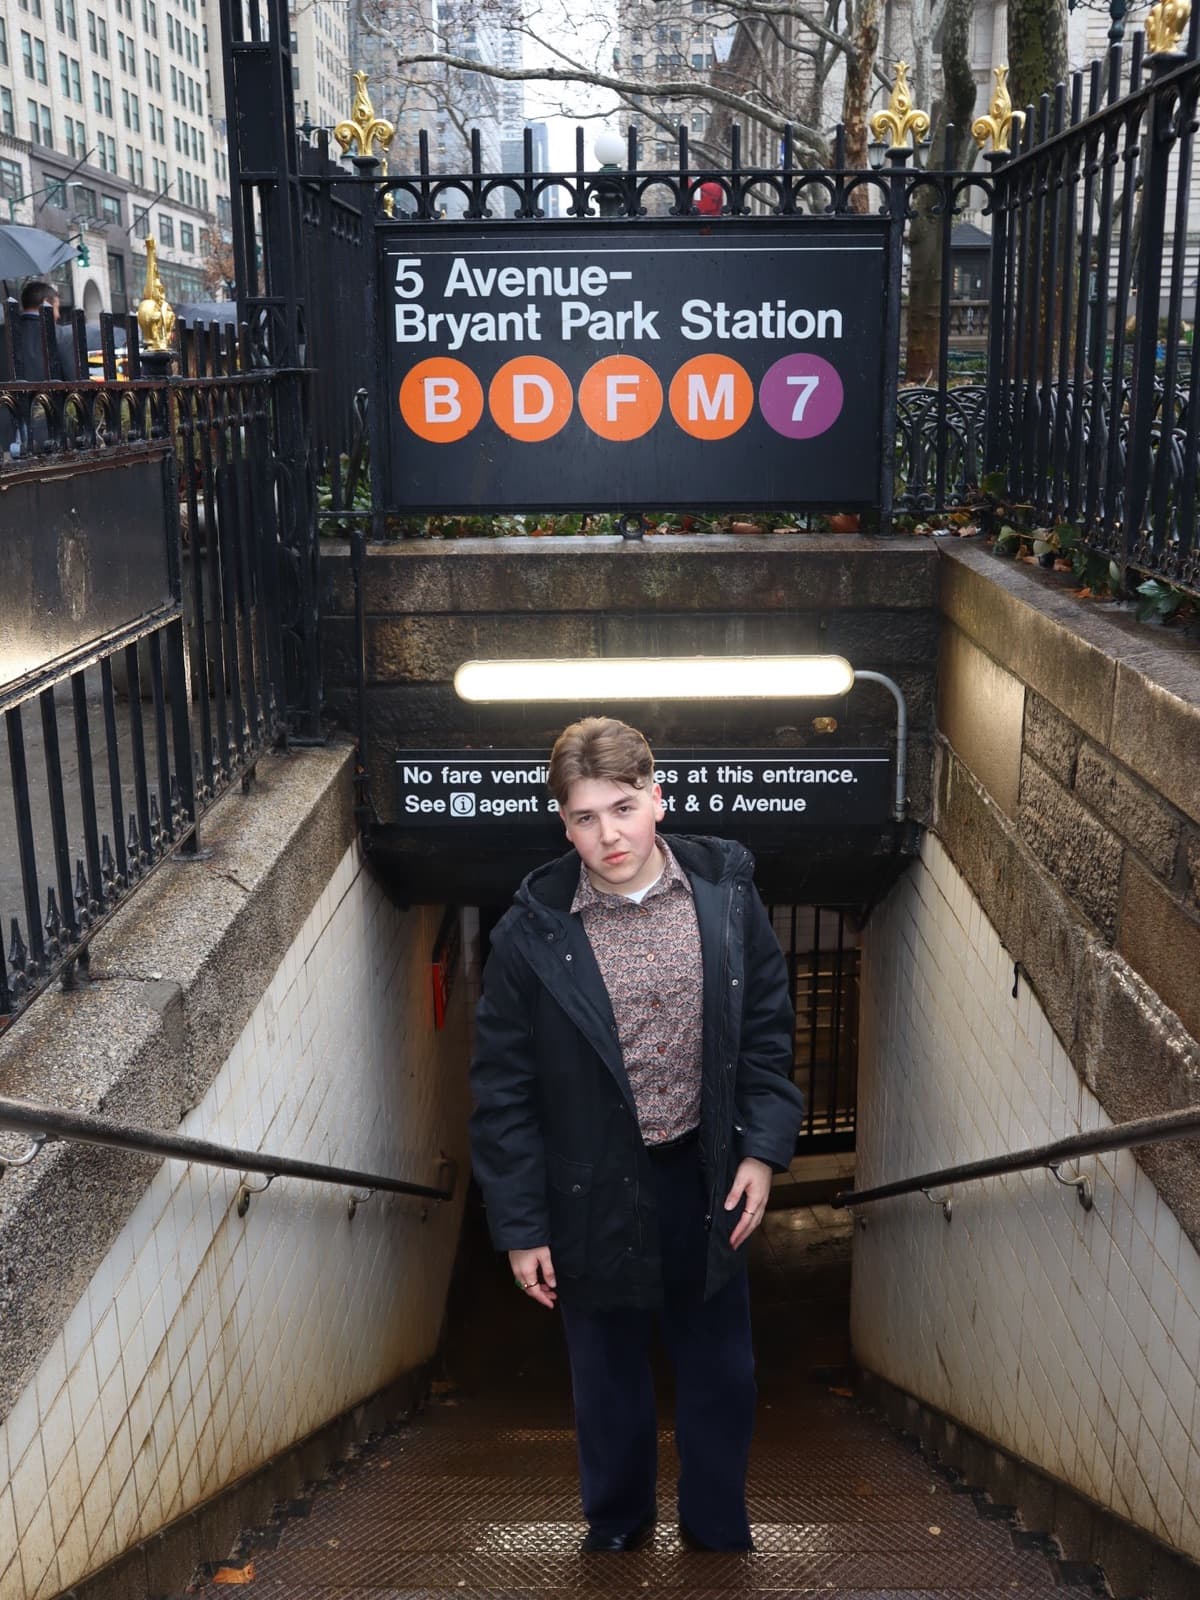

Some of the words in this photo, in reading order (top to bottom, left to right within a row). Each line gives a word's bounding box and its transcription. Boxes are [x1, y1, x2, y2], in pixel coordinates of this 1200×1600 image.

[394, 258, 424, 299] 5
[443, 257, 633, 298] Avenue-
[395, 303, 542, 350] Bryant
[561, 300, 661, 341] Park
[680, 298, 843, 341] Station
[423, 377, 462, 424] B
[512, 374, 555, 424] D
[605, 374, 641, 422] F
[687, 373, 735, 421] M
[786, 375, 820, 422] 7
[403, 766, 433, 784] No
[440, 766, 483, 784] fare
[491, 766, 550, 784] vendi
[687, 766, 708, 783] at
[716, 765, 754, 783] this
[762, 766, 858, 783] entrance.
[404, 794, 446, 813] See
[479, 795, 539, 817] agent
[684, 794, 700, 812] &
[709, 793, 724, 812] 6
[731, 794, 807, 812] Avenue
